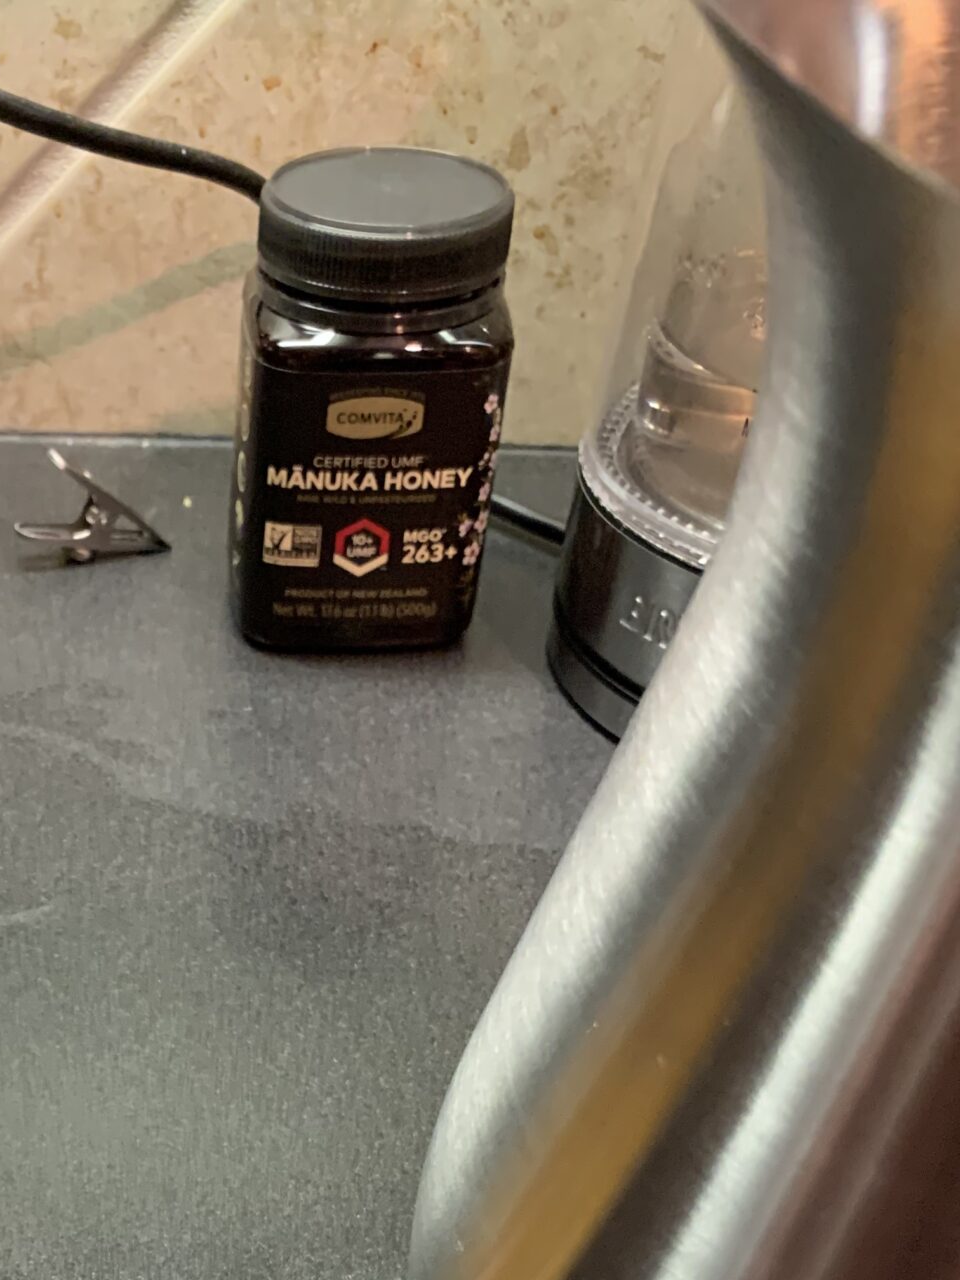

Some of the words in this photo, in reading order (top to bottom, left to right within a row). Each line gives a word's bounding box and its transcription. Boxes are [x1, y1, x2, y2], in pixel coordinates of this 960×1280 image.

[336, 411, 405, 425] COMVITA
[313, 455, 389, 469] CERTIFIED
[391, 455, 424, 469] UMF
[383, 466, 473, 491] HONEY
[351, 533, 373, 546] 10+
[403, 528, 443, 543] MGO
[346, 545, 377, 558] UMF
[401, 542, 458, 564] 263+
